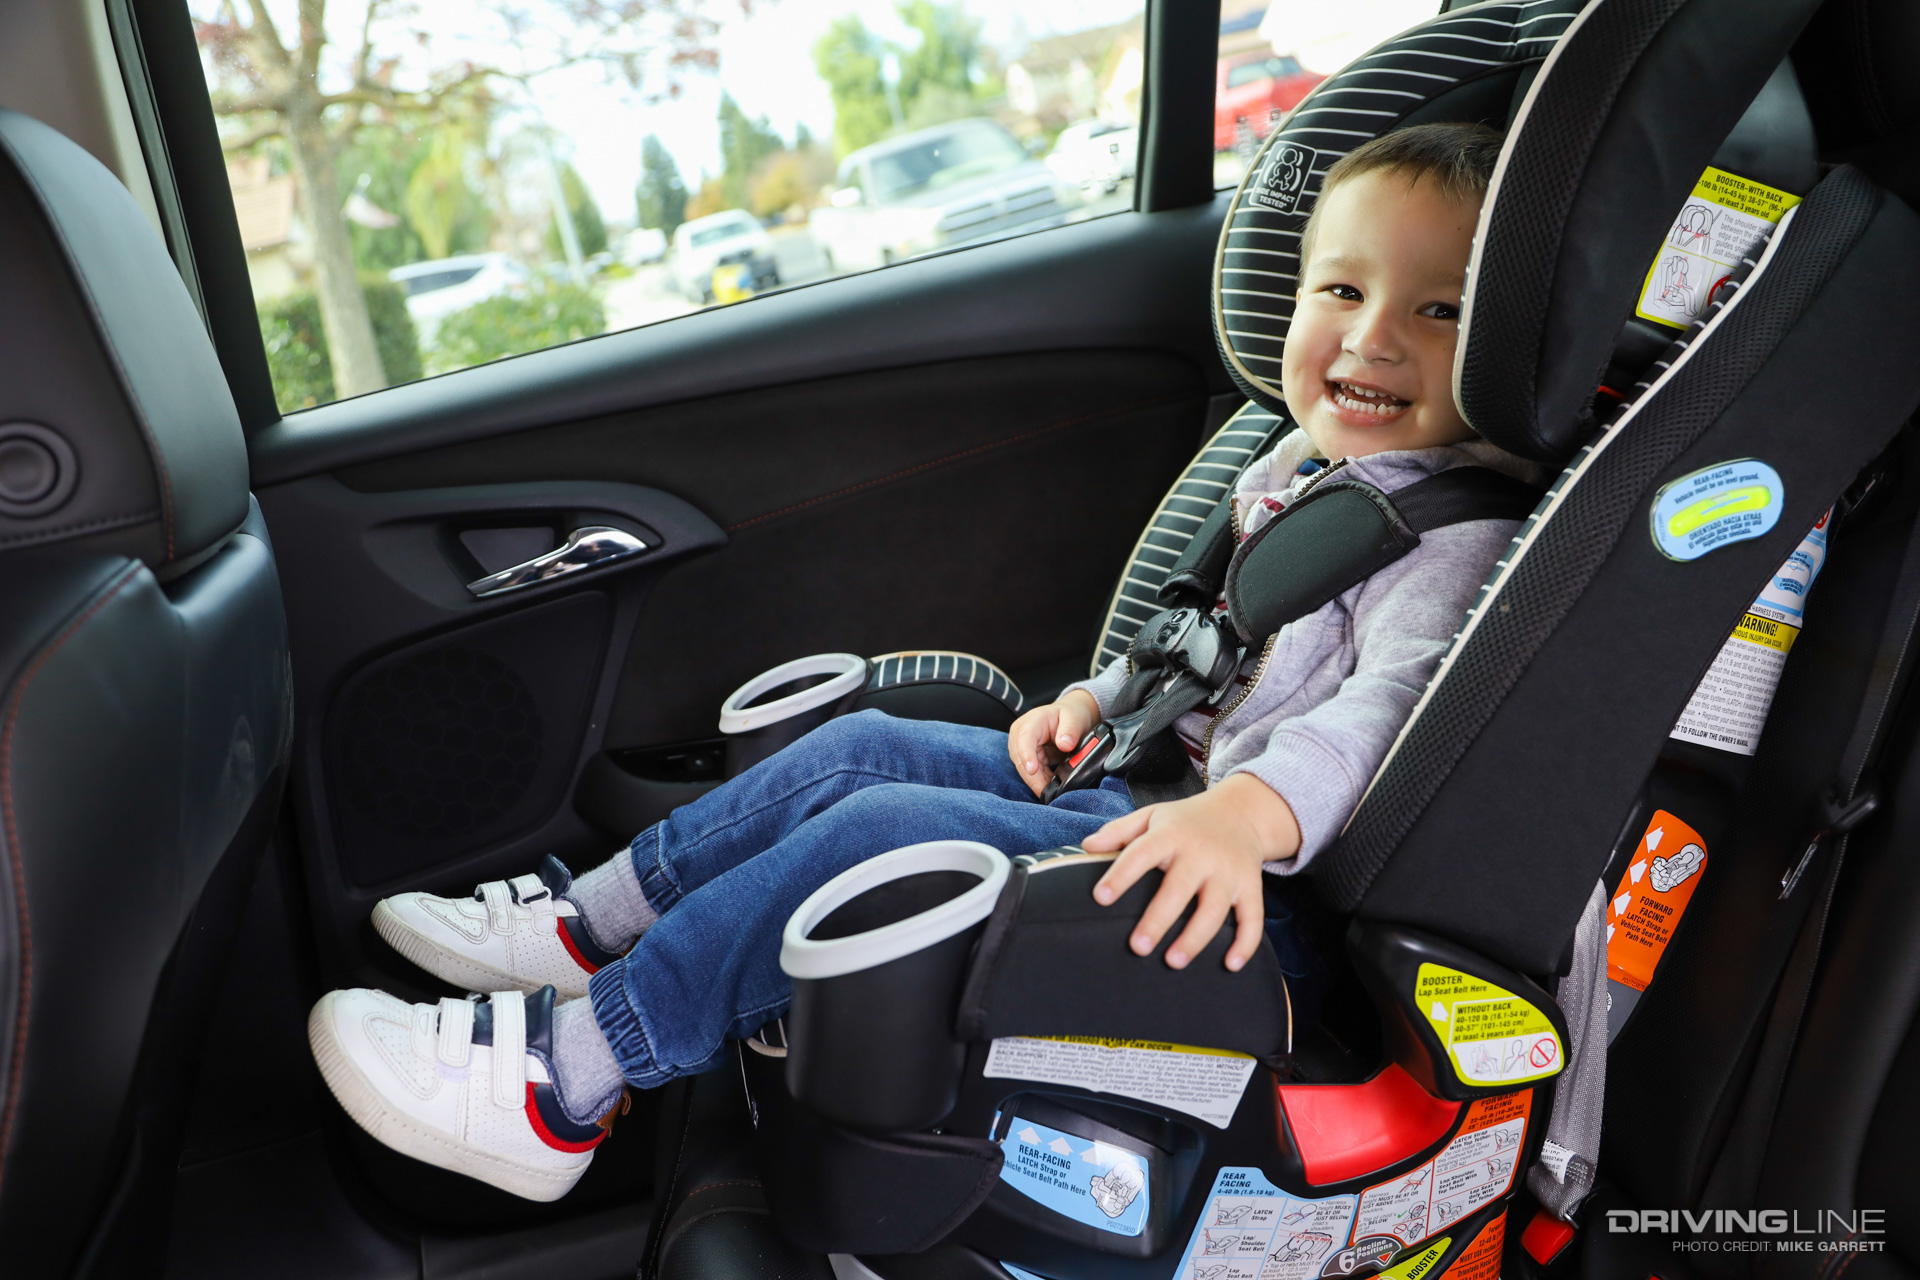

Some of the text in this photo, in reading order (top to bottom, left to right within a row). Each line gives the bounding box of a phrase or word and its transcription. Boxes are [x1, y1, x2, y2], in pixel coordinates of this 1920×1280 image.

[1270, 189, 1296, 203] IMPACT
[1718, 186, 1737, 197] (14-45
[1738, 192, 1747, 202] kg)
[1766, 191, 1784, 204] BACK
[1726, 199, 1739, 208] least
[1744, 206, 1759, 216] years
[1720, 222, 1752, 238] between the
[1725, 214, 1758, 231] The shoulder
[1715, 239, 1733, 250] guides
[1718, 231, 1732, 242] edge
[1712, 248, 1724, 256] just
[1694, 467, 1733, 486] REAR-FACING
[1675, 491, 1694, 504] Vehicle
[1695, 484, 1708, 494] must
[1725, 476, 1738, 484] level
[1689, 520, 1722, 540] ORIENTADO
[1723, 516, 1741, 525] HACIA
[1752, 605, 1772, 617] HARNESS
[1749, 633, 1764, 643] INJURY
[1688, 728, 1708, 738] FOLLOW
[1709, 733, 1718, 741] THE
[1640, 896, 1674, 916] FORWARD
[1626, 912, 1646, 925] LATCH
[1646, 920, 1662, 933] Strap
[1640, 907, 1665, 923] FACING
[1620, 919, 1668, 944] Vehicle Seat Belt
[1625, 931, 1653, 948] Path Here
[1422, 976, 1463, 986] BOOSTER
[1419, 989, 1432, 997] Lap
[1434, 987, 1451, 995] Seat
[1456, 1014, 1480, 1023] 40-120
[1490, 1011, 1518, 1021] (18.1-54
[1520, 1009, 1530, 1018] kg)
[1457, 1002, 1512, 1014] WITHOUT BACK
[1481, 1021, 1511, 1031] (101-145
[1486, 1031, 1504, 1039] years
[1484, 1099, 1512, 1112] FACING
[1470, 1113, 1488, 1124] 22-65
[1495, 1107, 1514, 1117] (10-30
[1480, 1119, 1493, 1127] (125
[1019, 1144, 1072, 1170] REAR-FACING
[1018, 1155, 1038, 1168] LATCH
[1040, 1163, 1058, 1176] Strap
[1023, 1167, 1038, 1178] Seat
[1039, 1172, 1052, 1184] Belt
[1053, 1179, 1069, 1190] Path
[1070, 1185, 1086, 1195] Here
[1338, 1240, 1387, 1273] 6 Recline
[1357, 1242, 1393, 1259] Positions
[1460, 1249, 1483, 1263] MUST USE
[1406, 1248, 1439, 1280] BOOSTER
[1458, 1265, 1479, 1277] Orientado
